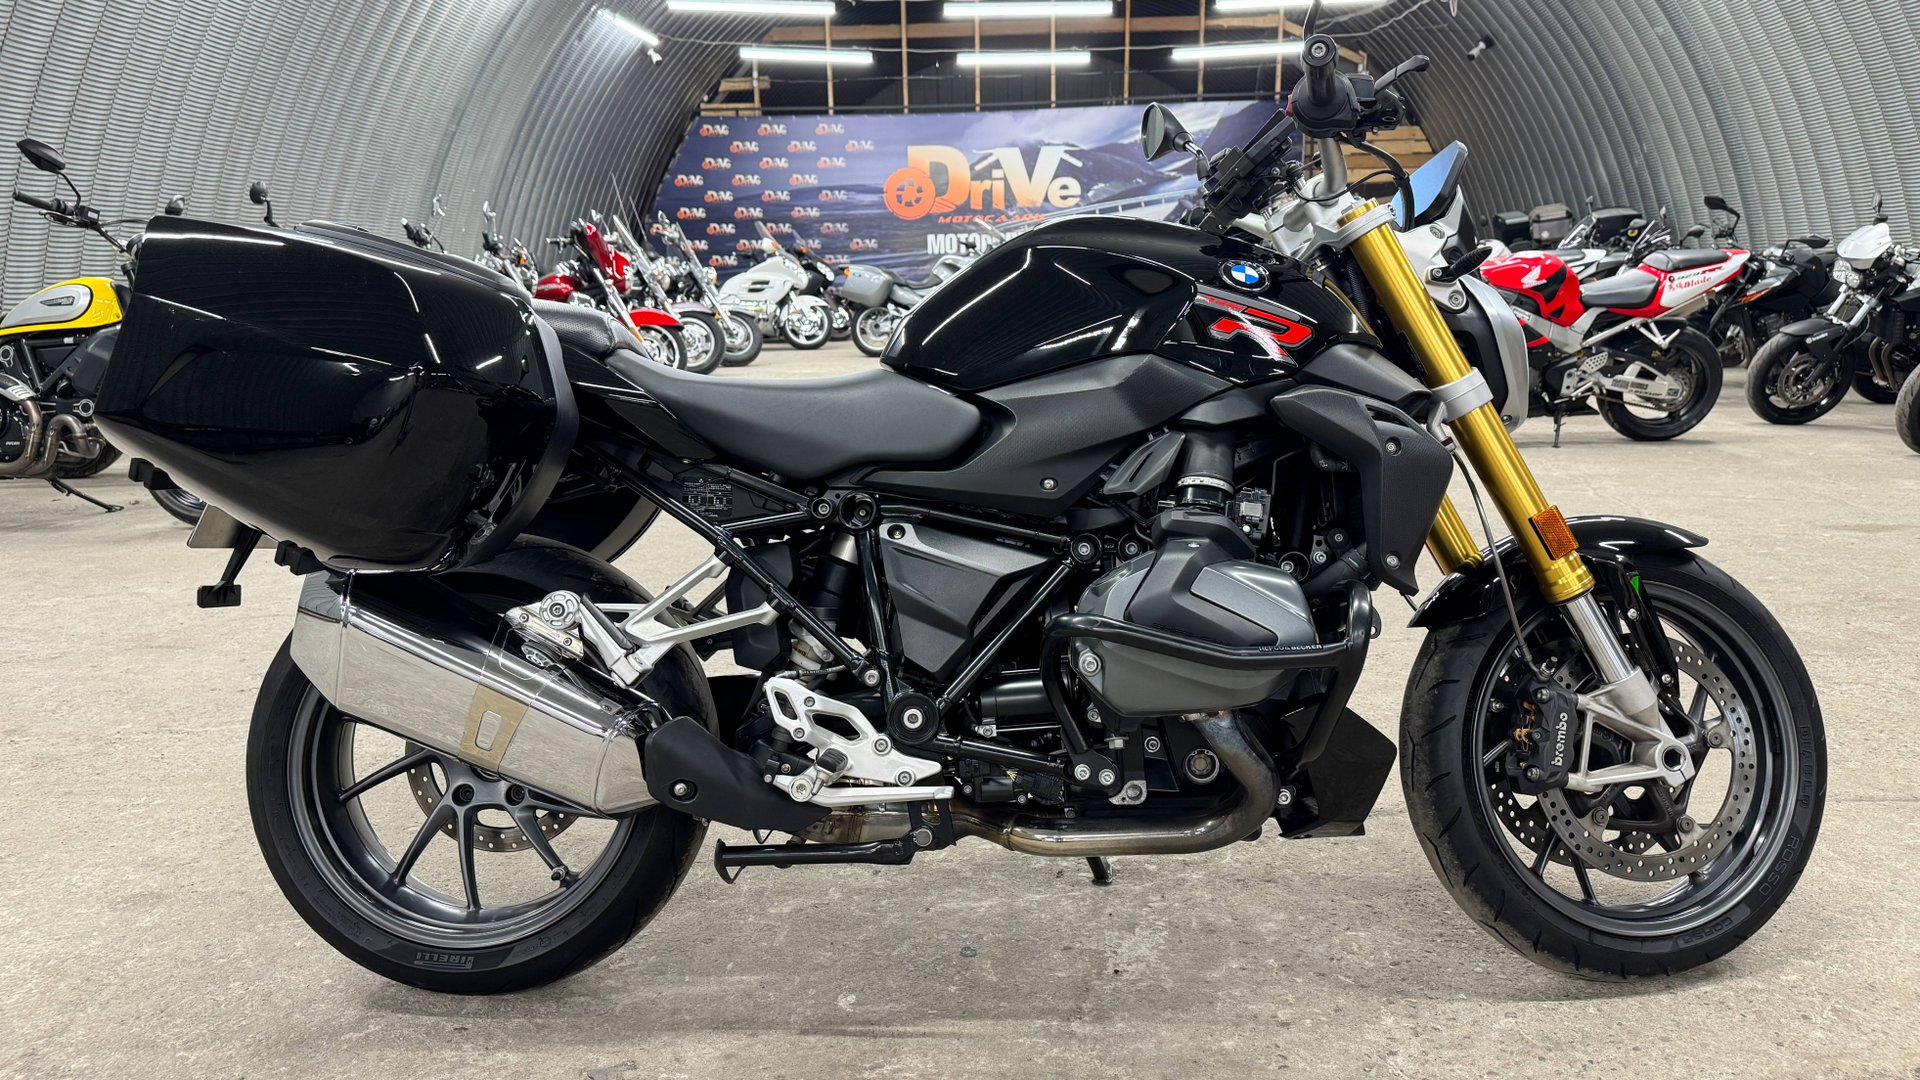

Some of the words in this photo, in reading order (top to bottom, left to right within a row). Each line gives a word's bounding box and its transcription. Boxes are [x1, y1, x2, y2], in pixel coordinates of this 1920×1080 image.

[907, 144, 1083, 211] DriVe
[1551, 712, 1568, 767] brembo
[1759, 834, 1800, 896] ROSSO
[414, 951, 475, 969] PIRELLI
